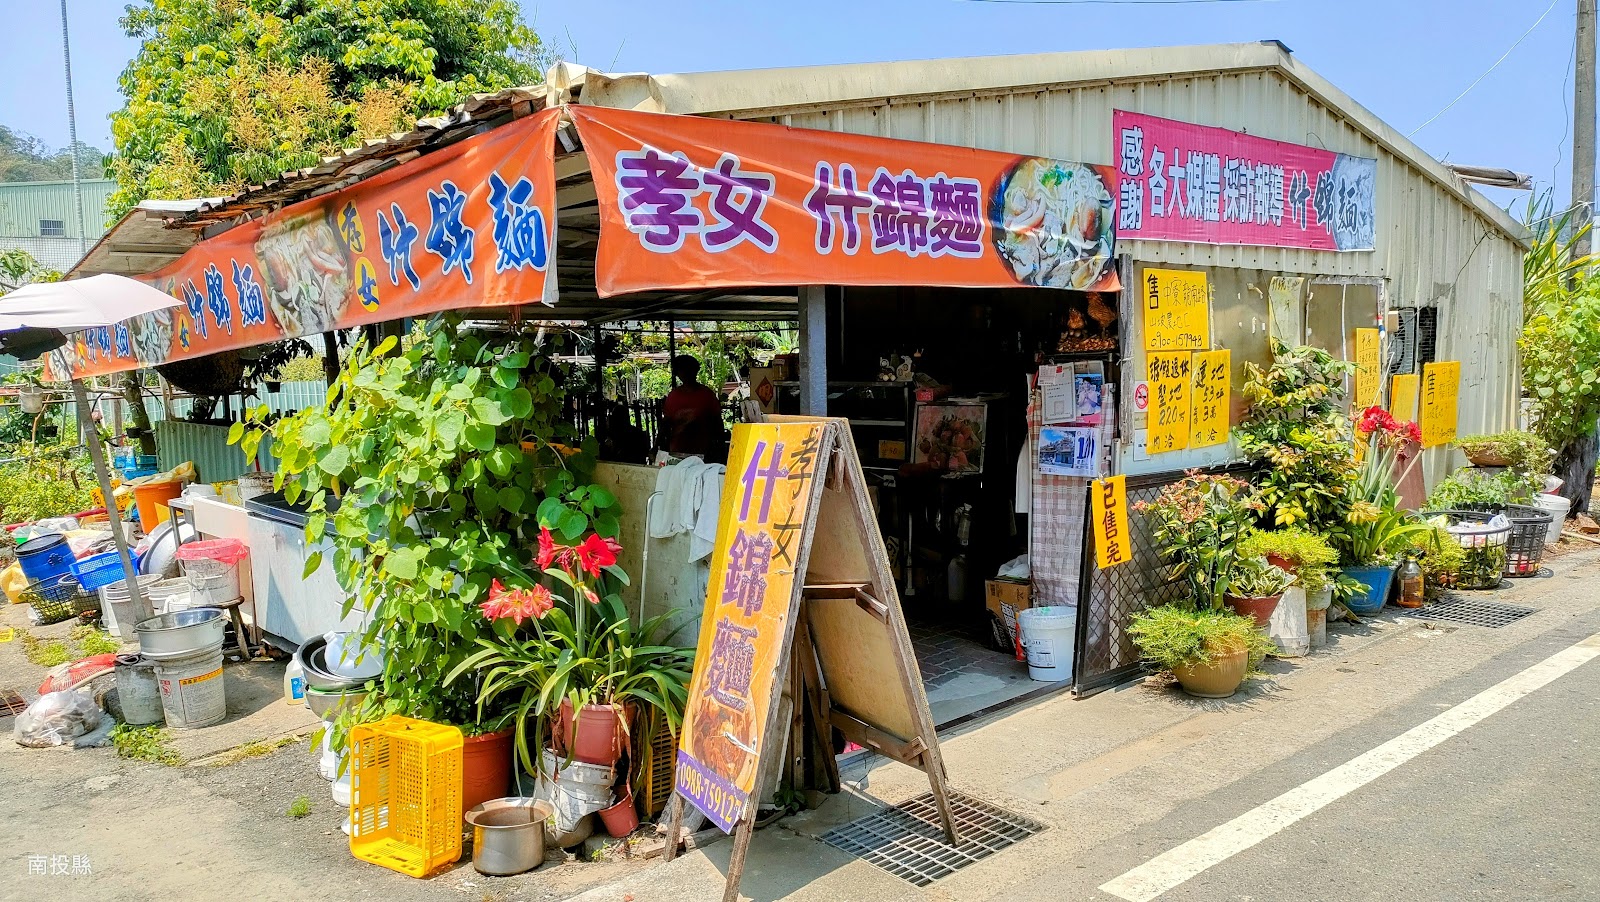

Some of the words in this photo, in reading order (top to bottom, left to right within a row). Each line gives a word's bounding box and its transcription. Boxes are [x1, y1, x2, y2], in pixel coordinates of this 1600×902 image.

[615, 146, 778, 254] 孝女
[805, 161, 984, 258] 什錦麵
[1119, 125, 1144, 230] 感謝
[1148, 145, 1221, 222] 各大媒體
[1289, 169, 1359, 235] 什錦麵
[376, 170, 548, 292] 什錦麵
[181, 257, 266, 340] 什錦麵
[1147, 273, 1159, 310] 售
[771, 427, 821, 567] 孝女
[1102, 481, 1122, 565] 已售完
[703, 441, 790, 713] 什錦麵
